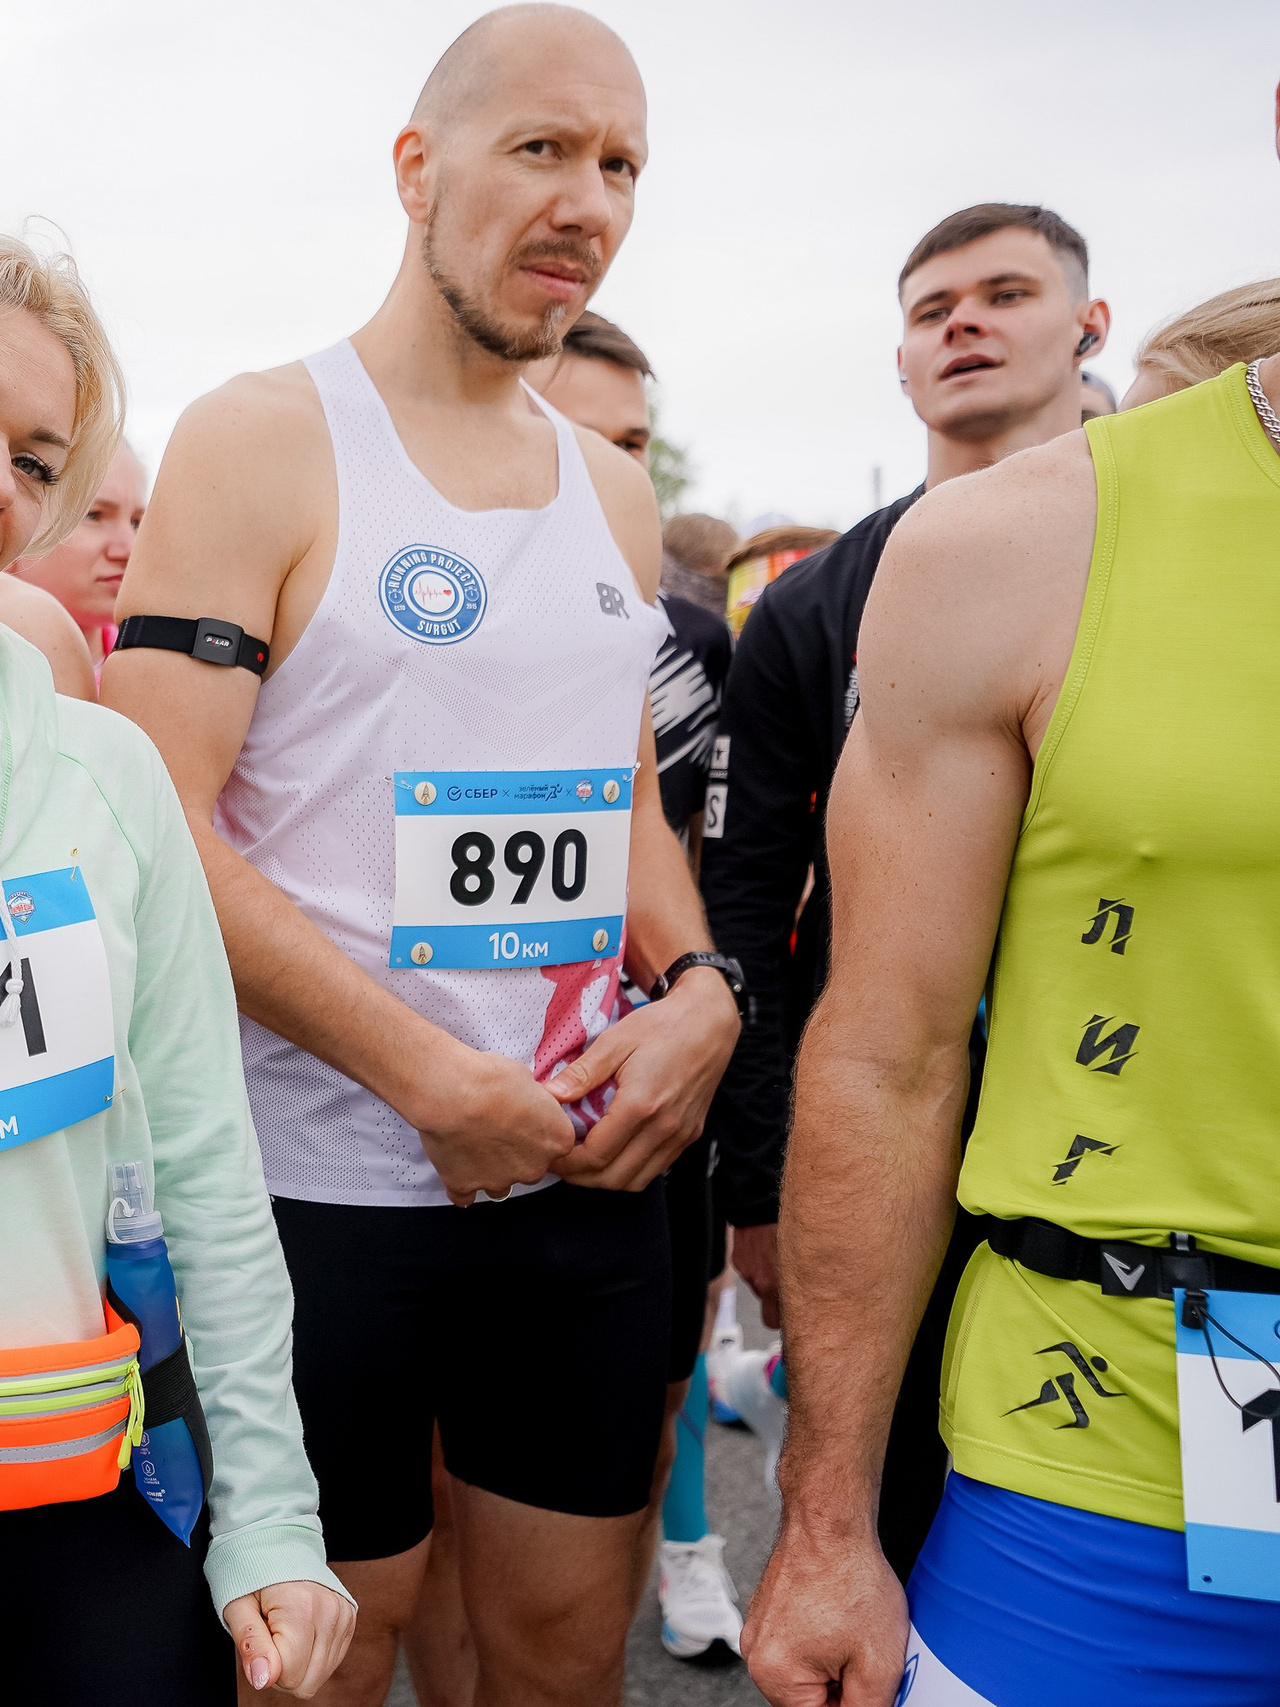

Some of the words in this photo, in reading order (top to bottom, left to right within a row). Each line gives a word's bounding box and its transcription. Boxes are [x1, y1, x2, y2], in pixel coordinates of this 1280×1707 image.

[387, 551, 428, 588] RUNNING
[430, 553, 477, 588] PROJECT
[417, 619, 462, 636] SURGUT
[465, 789, 498, 799] СБЕР
[450, 829, 587, 907] 890
[489, 931, 520, 960] 10
